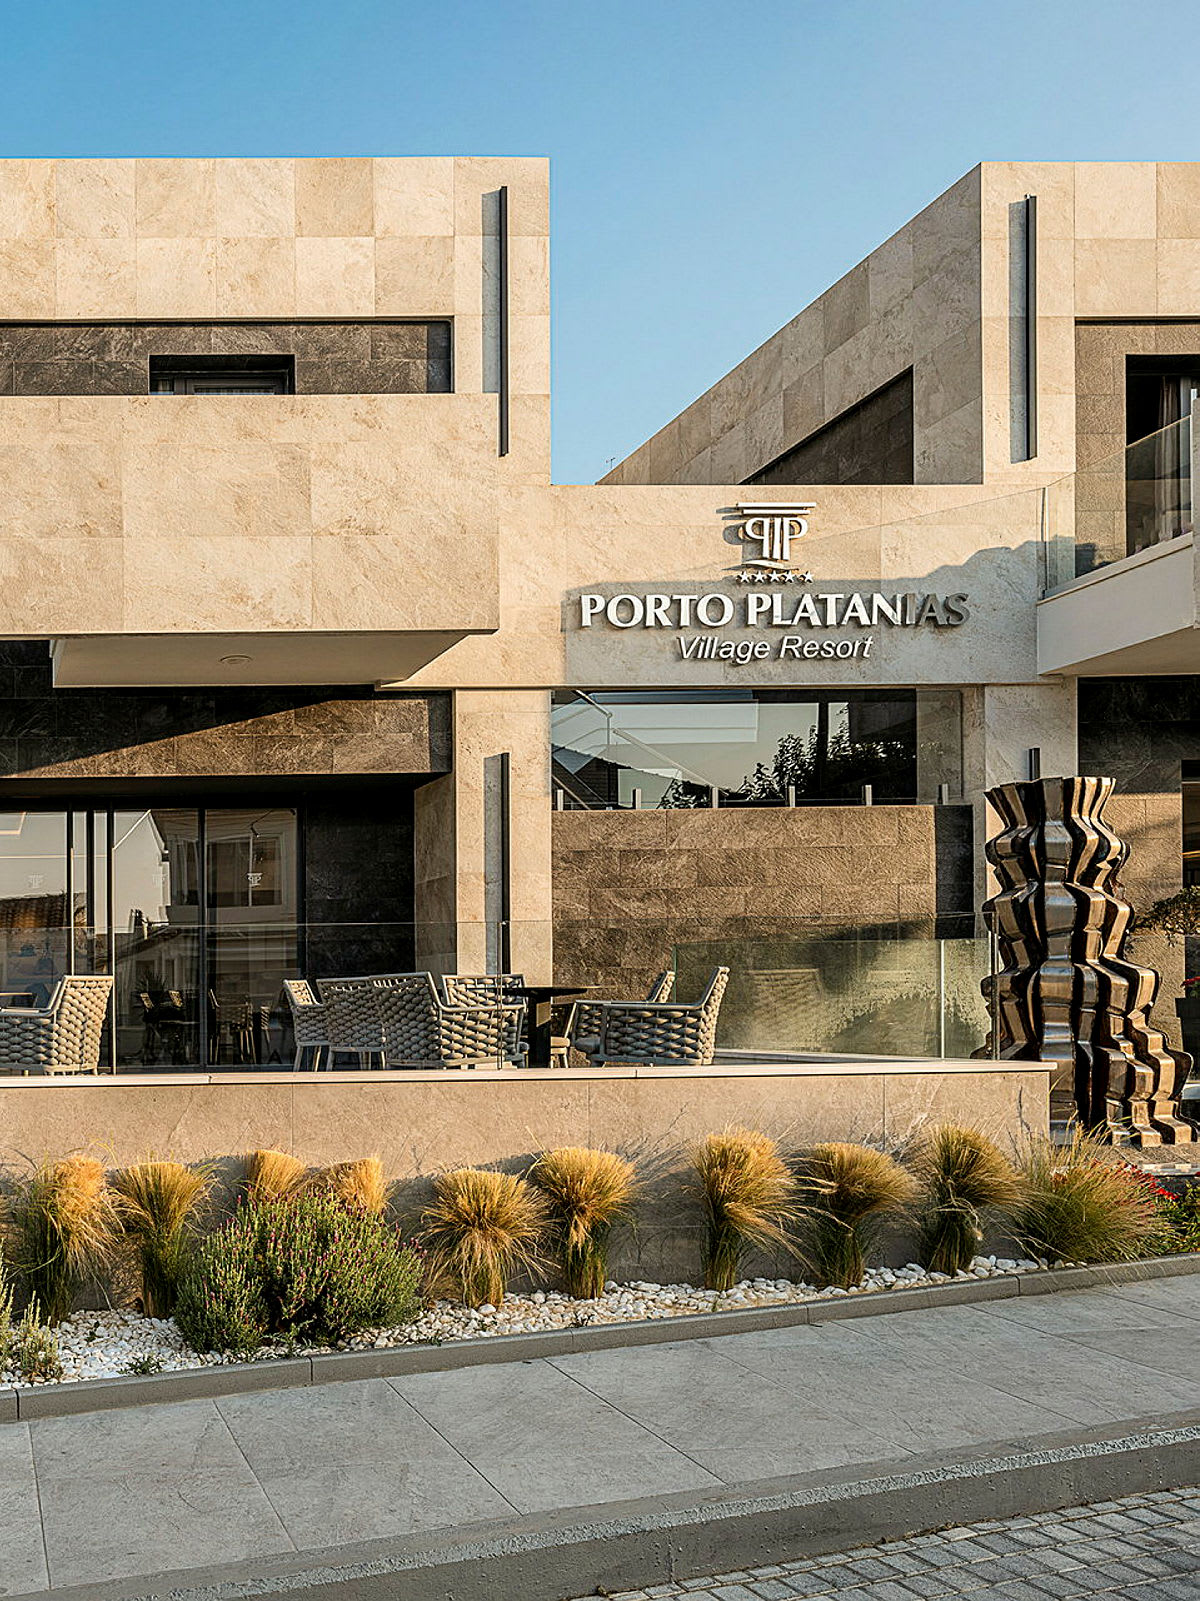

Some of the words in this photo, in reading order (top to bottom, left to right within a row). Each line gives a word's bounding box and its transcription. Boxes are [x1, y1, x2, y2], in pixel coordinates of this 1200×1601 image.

[580, 593, 735, 628] PORTO
[746, 593, 971, 627] PLATANIAS
[678, 635, 770, 664] Village
[780, 635, 874, 659] Resort
